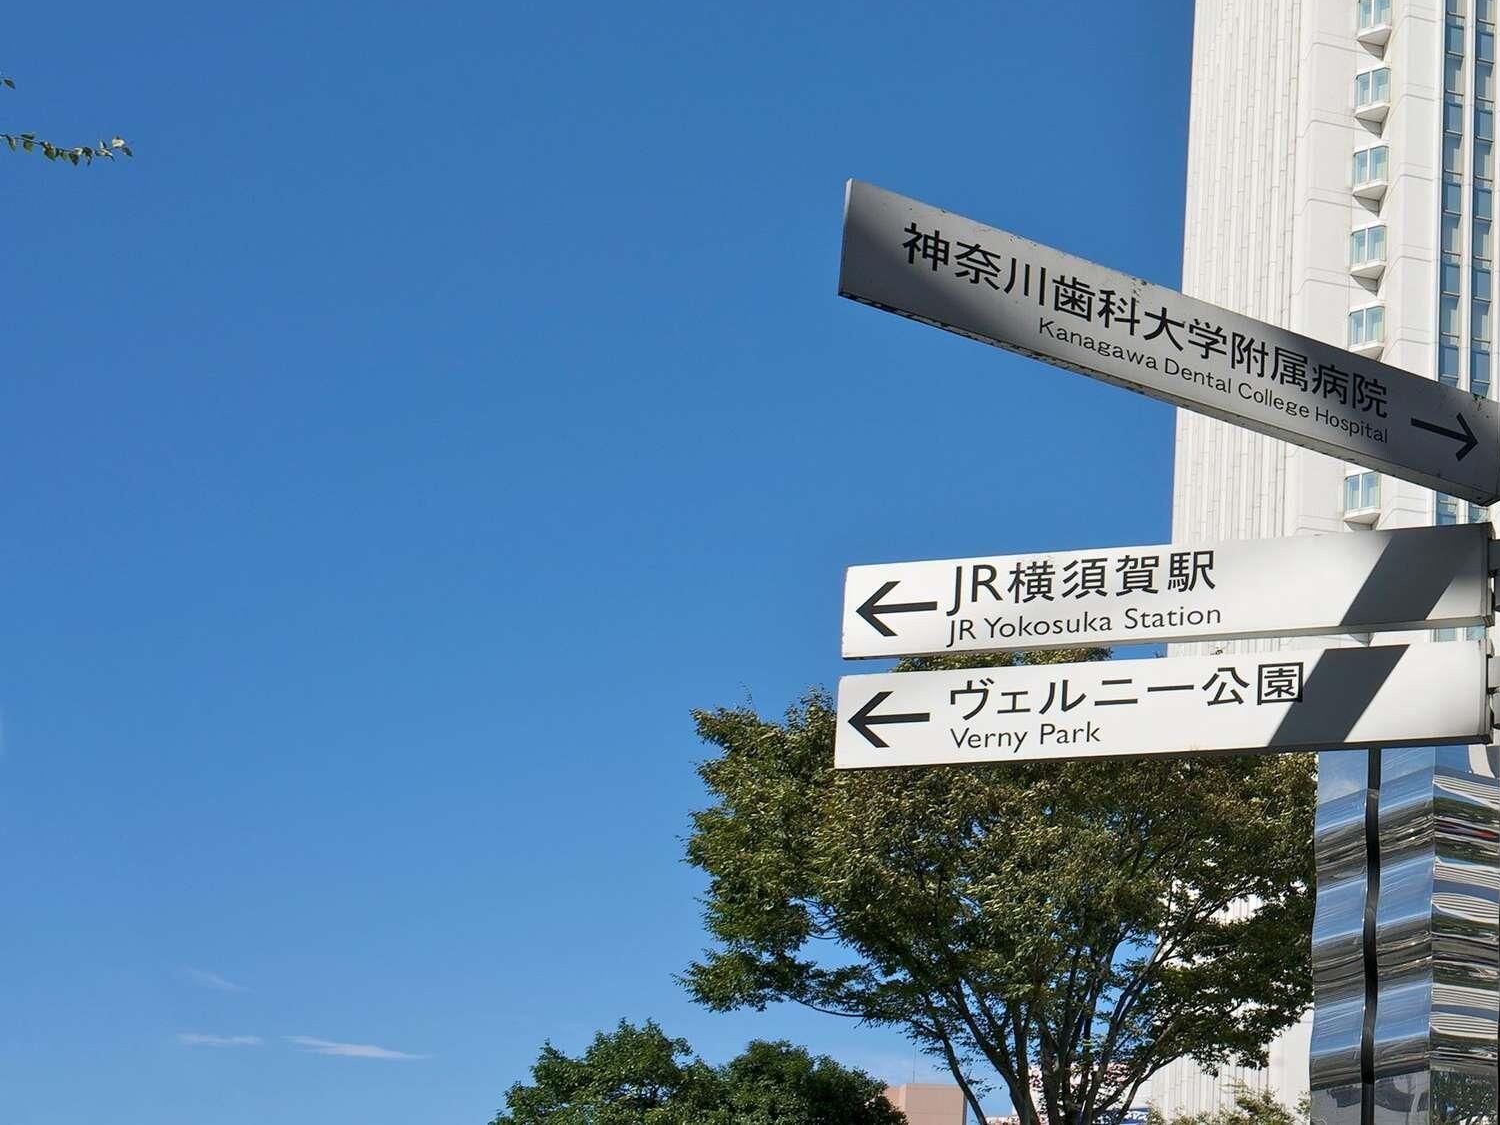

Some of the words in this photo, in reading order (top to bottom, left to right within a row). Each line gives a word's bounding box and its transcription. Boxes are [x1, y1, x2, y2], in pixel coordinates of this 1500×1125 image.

[903, 222, 1388, 419] 神奈川歯科大学附属病院
[1039, 317, 1159, 371] Kanagawa
[1164, 358, 1232, 394] Dental
[1238, 382, 1310, 419] College
[1315, 406, 1388, 444] Hospital
[946, 550, 1216, 617] JR横須賀駅
[946, 619, 976, 648] JR
[984, 610, 1113, 639] Yokosuka
[1124, 606, 1222, 630] Station
[949, 661, 1305, 721] ヴェルニー公園
[949, 727, 1029, 754] Verny
[1039, 721, 1101, 745] Park
